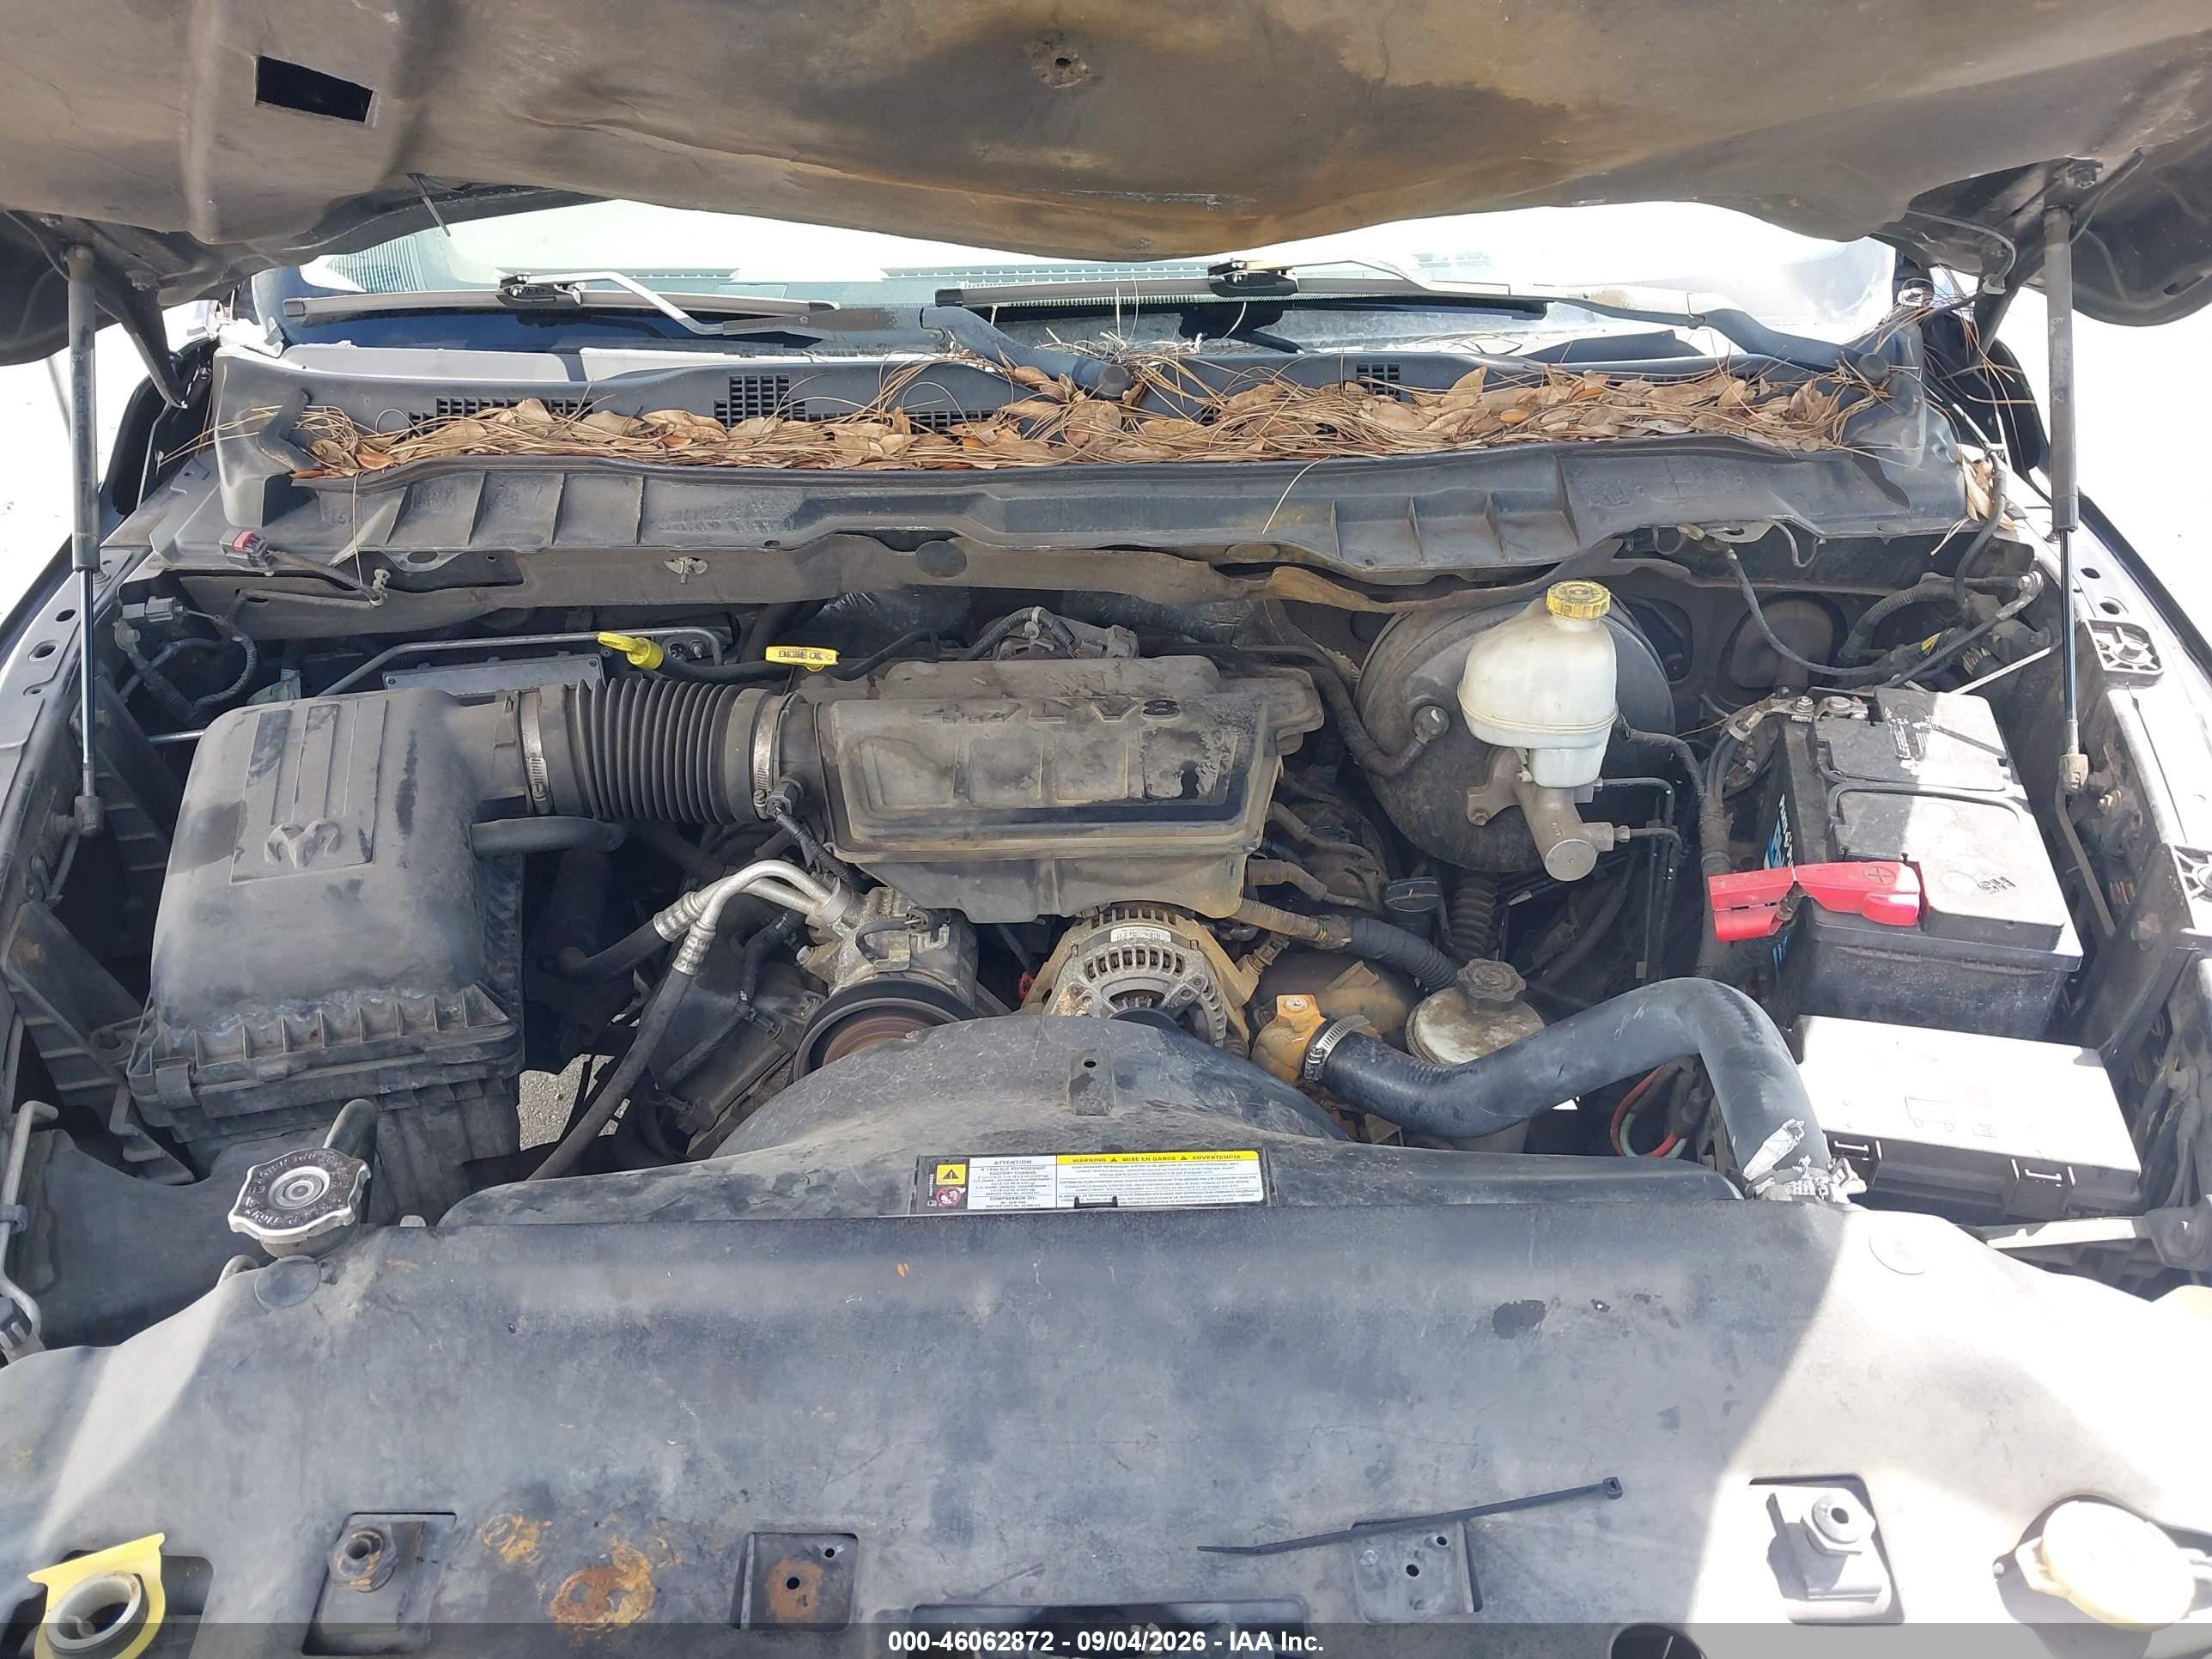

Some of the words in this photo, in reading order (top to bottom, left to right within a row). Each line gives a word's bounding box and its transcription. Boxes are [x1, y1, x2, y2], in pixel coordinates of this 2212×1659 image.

[778, 650, 807, 659] ENGINE
[809, 652, 823, 660] OIL
[1091, 698, 1182, 724] V8
